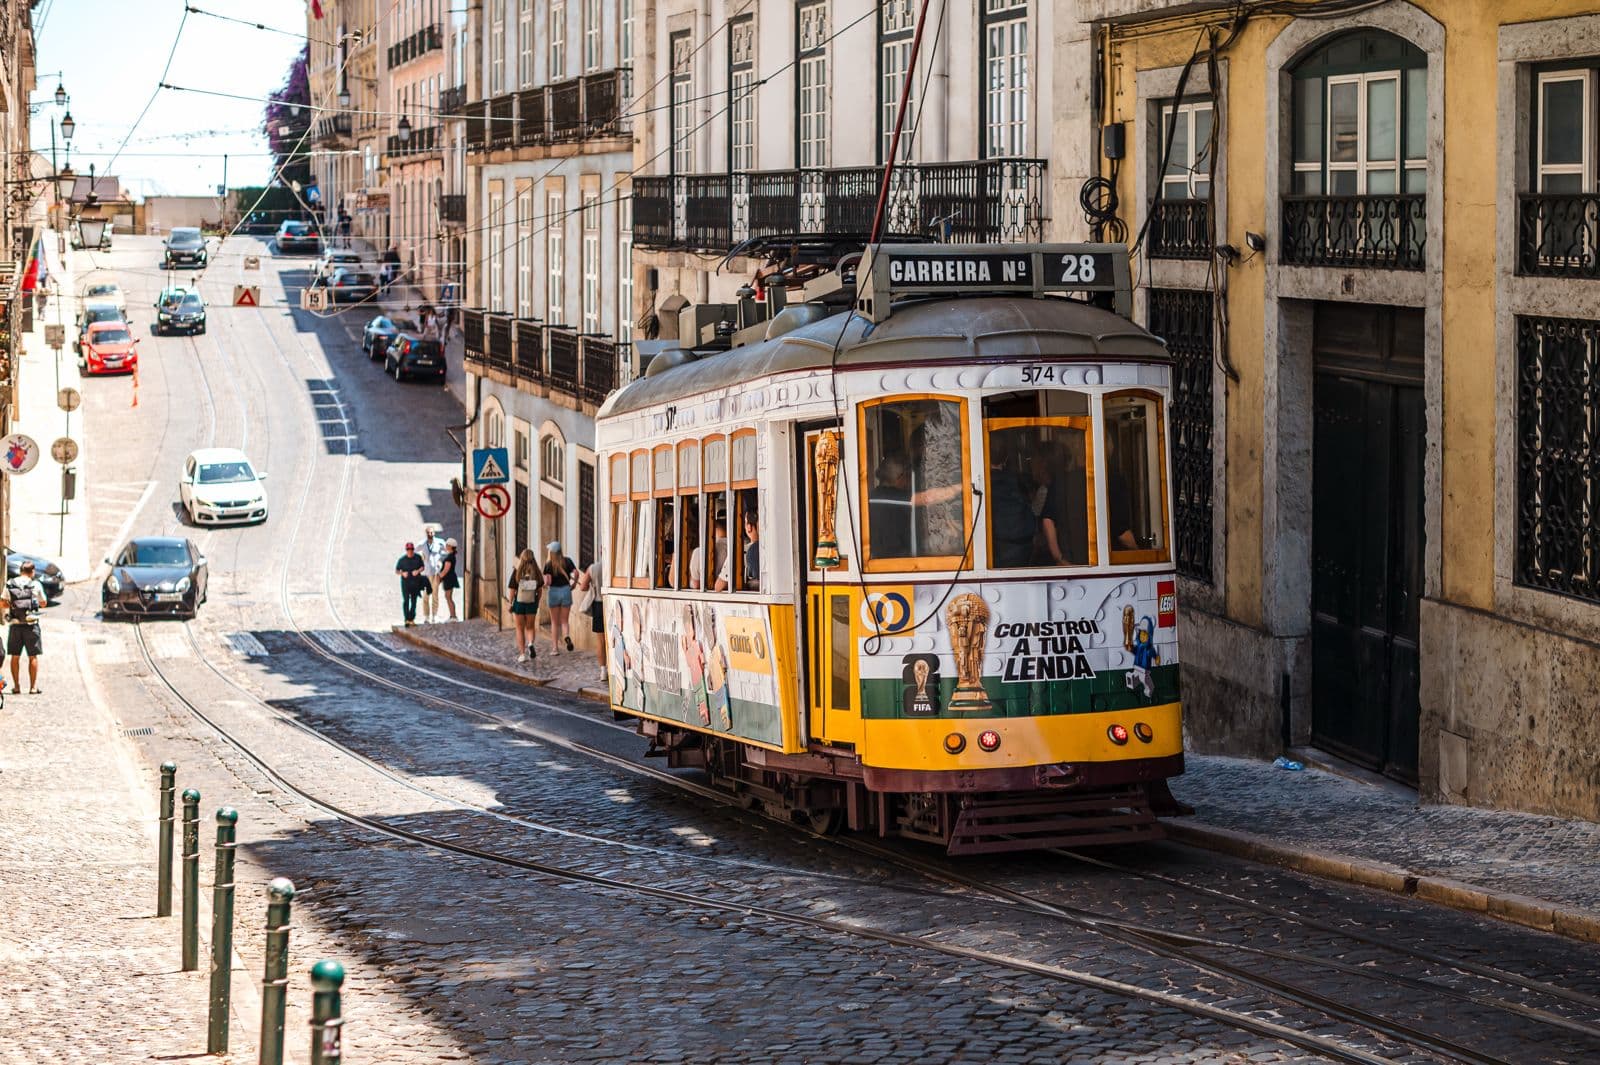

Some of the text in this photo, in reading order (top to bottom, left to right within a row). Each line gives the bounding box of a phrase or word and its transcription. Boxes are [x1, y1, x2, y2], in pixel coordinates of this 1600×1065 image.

[890, 260, 991, 282] CARREIRA
[1061, 254, 1096, 282] 28
[309, 293, 319, 303] 15
[1021, 366, 1054, 382] 574
[1159, 596, 1175, 612] LEGO
[994, 617, 1099, 638] CONSTRÓI
[1012, 635, 1085, 656] A TUA
[1003, 655, 1094, 681] LENDA
[913, 703, 932, 712] FIFA
